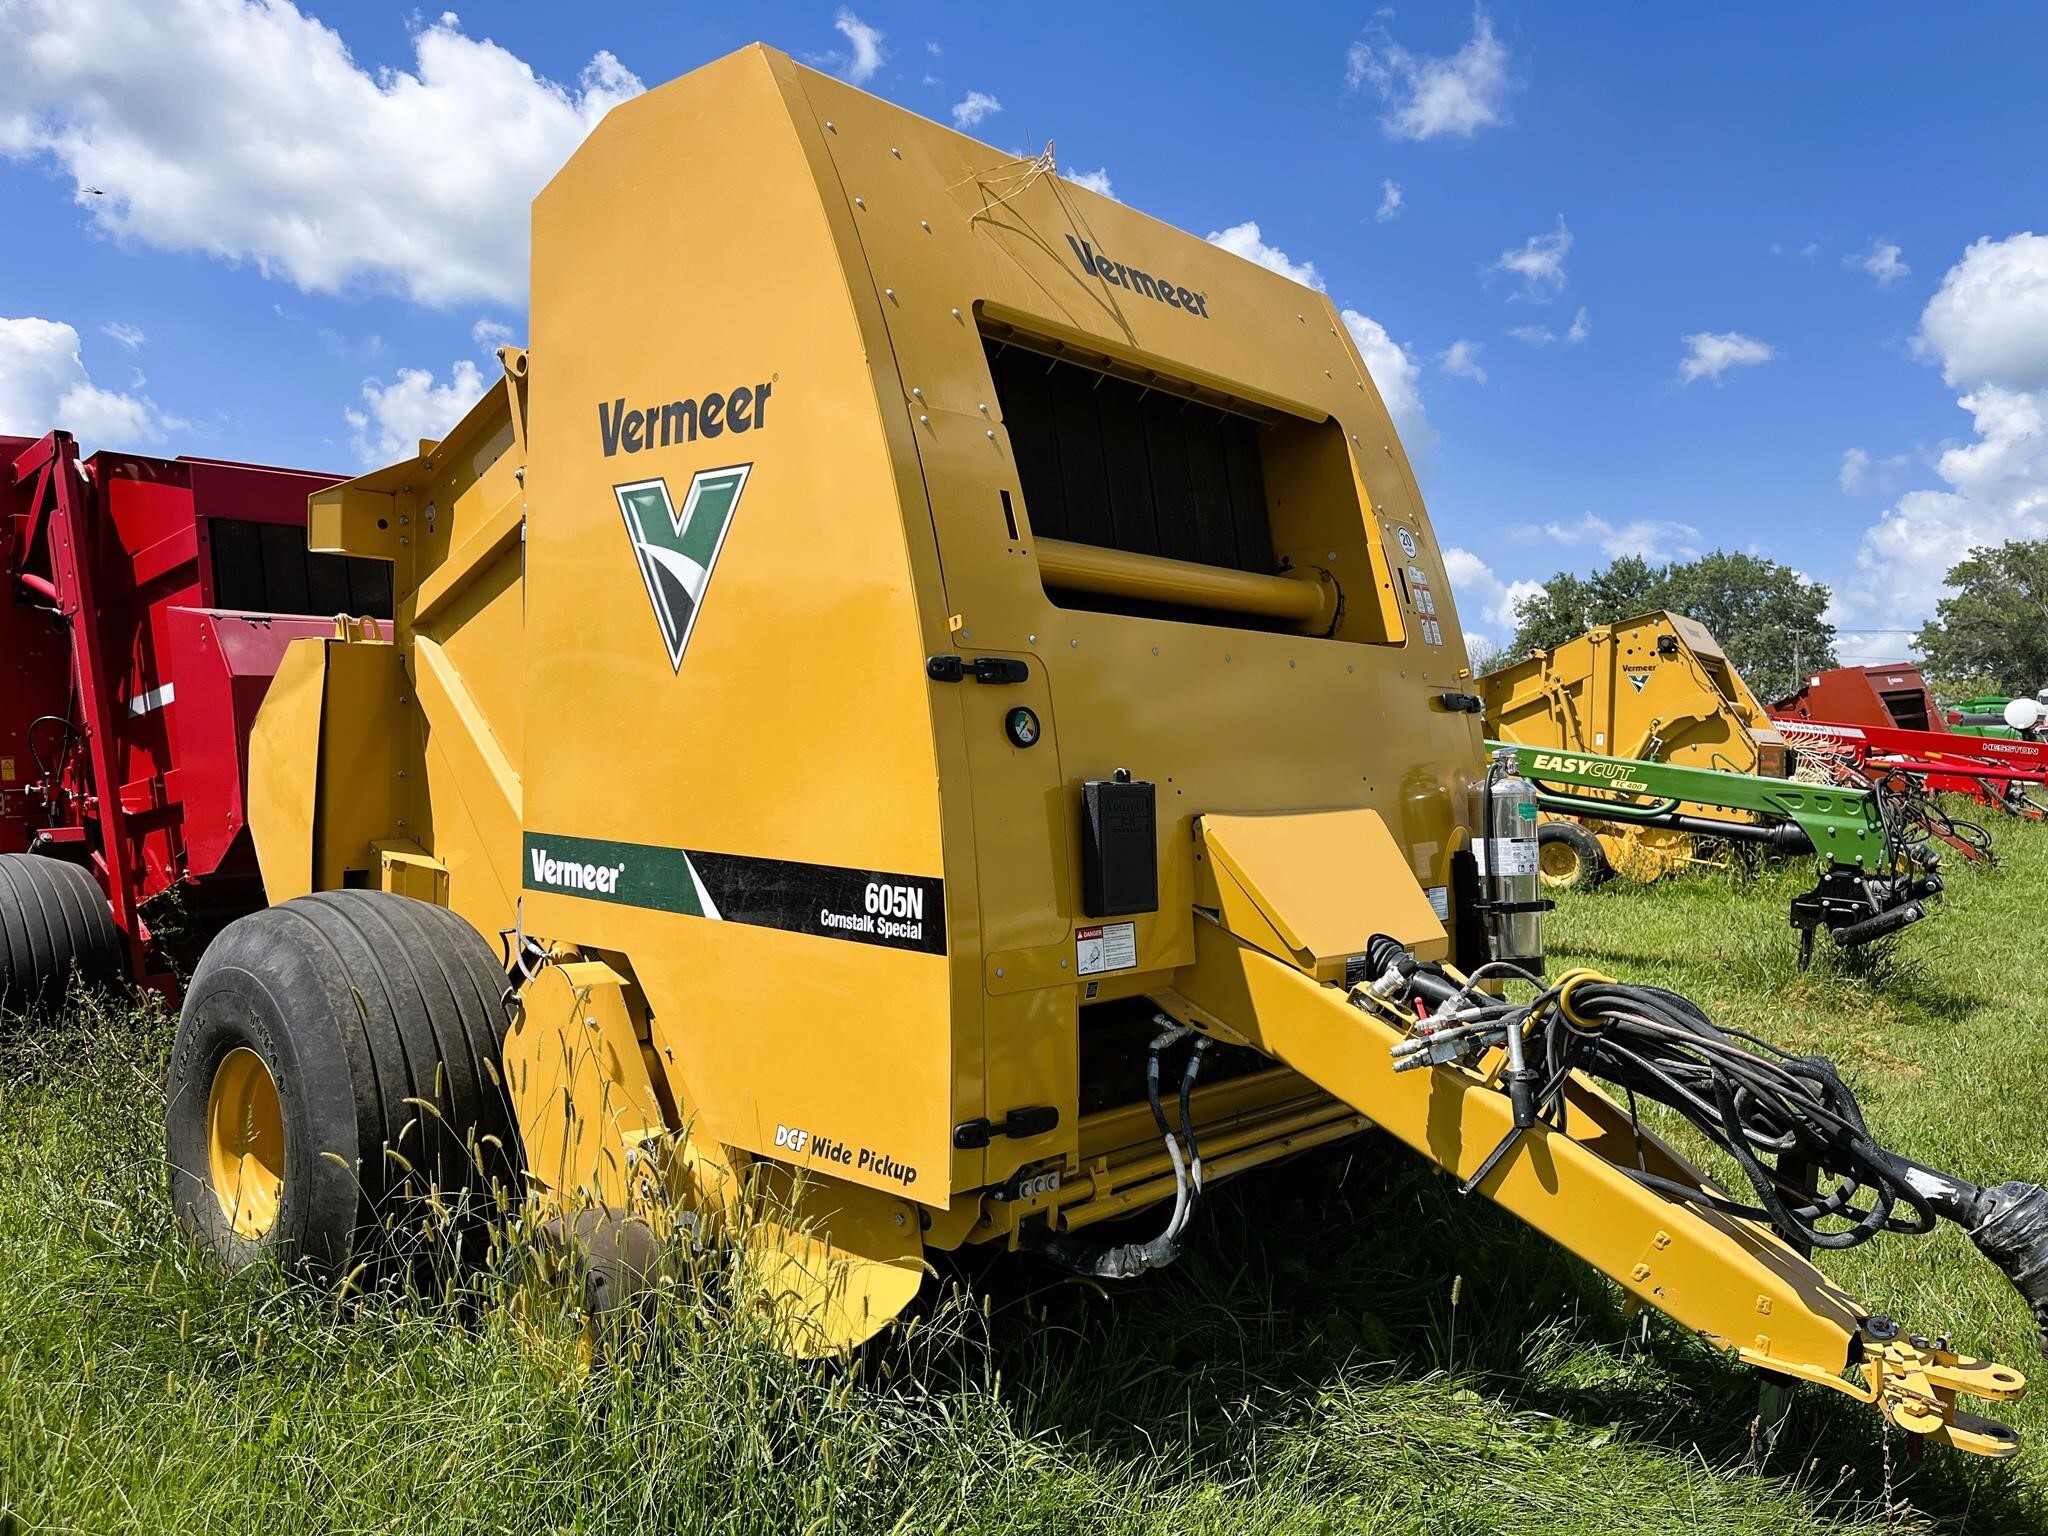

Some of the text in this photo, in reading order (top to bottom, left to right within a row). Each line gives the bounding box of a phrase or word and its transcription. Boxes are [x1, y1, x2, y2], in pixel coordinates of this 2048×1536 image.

[1065, 233, 1209, 319] Vermeer
[598, 382, 772, 458] Vermeer
[1400, 532, 1411, 547] 20
[1622, 664, 1656, 672] Vermeer
[1983, 743, 2039, 755] HESSTON
[1533, 754, 1636, 781] EASYCUT
[531, 848, 619, 894] Vermeer
[865, 882, 923, 920] 605N
[820, 908, 922, 940] Cornstalk Special
[1083, 929, 1103, 938] DANGER
[774, 1124, 917, 1186] DCF Wide Pickup
